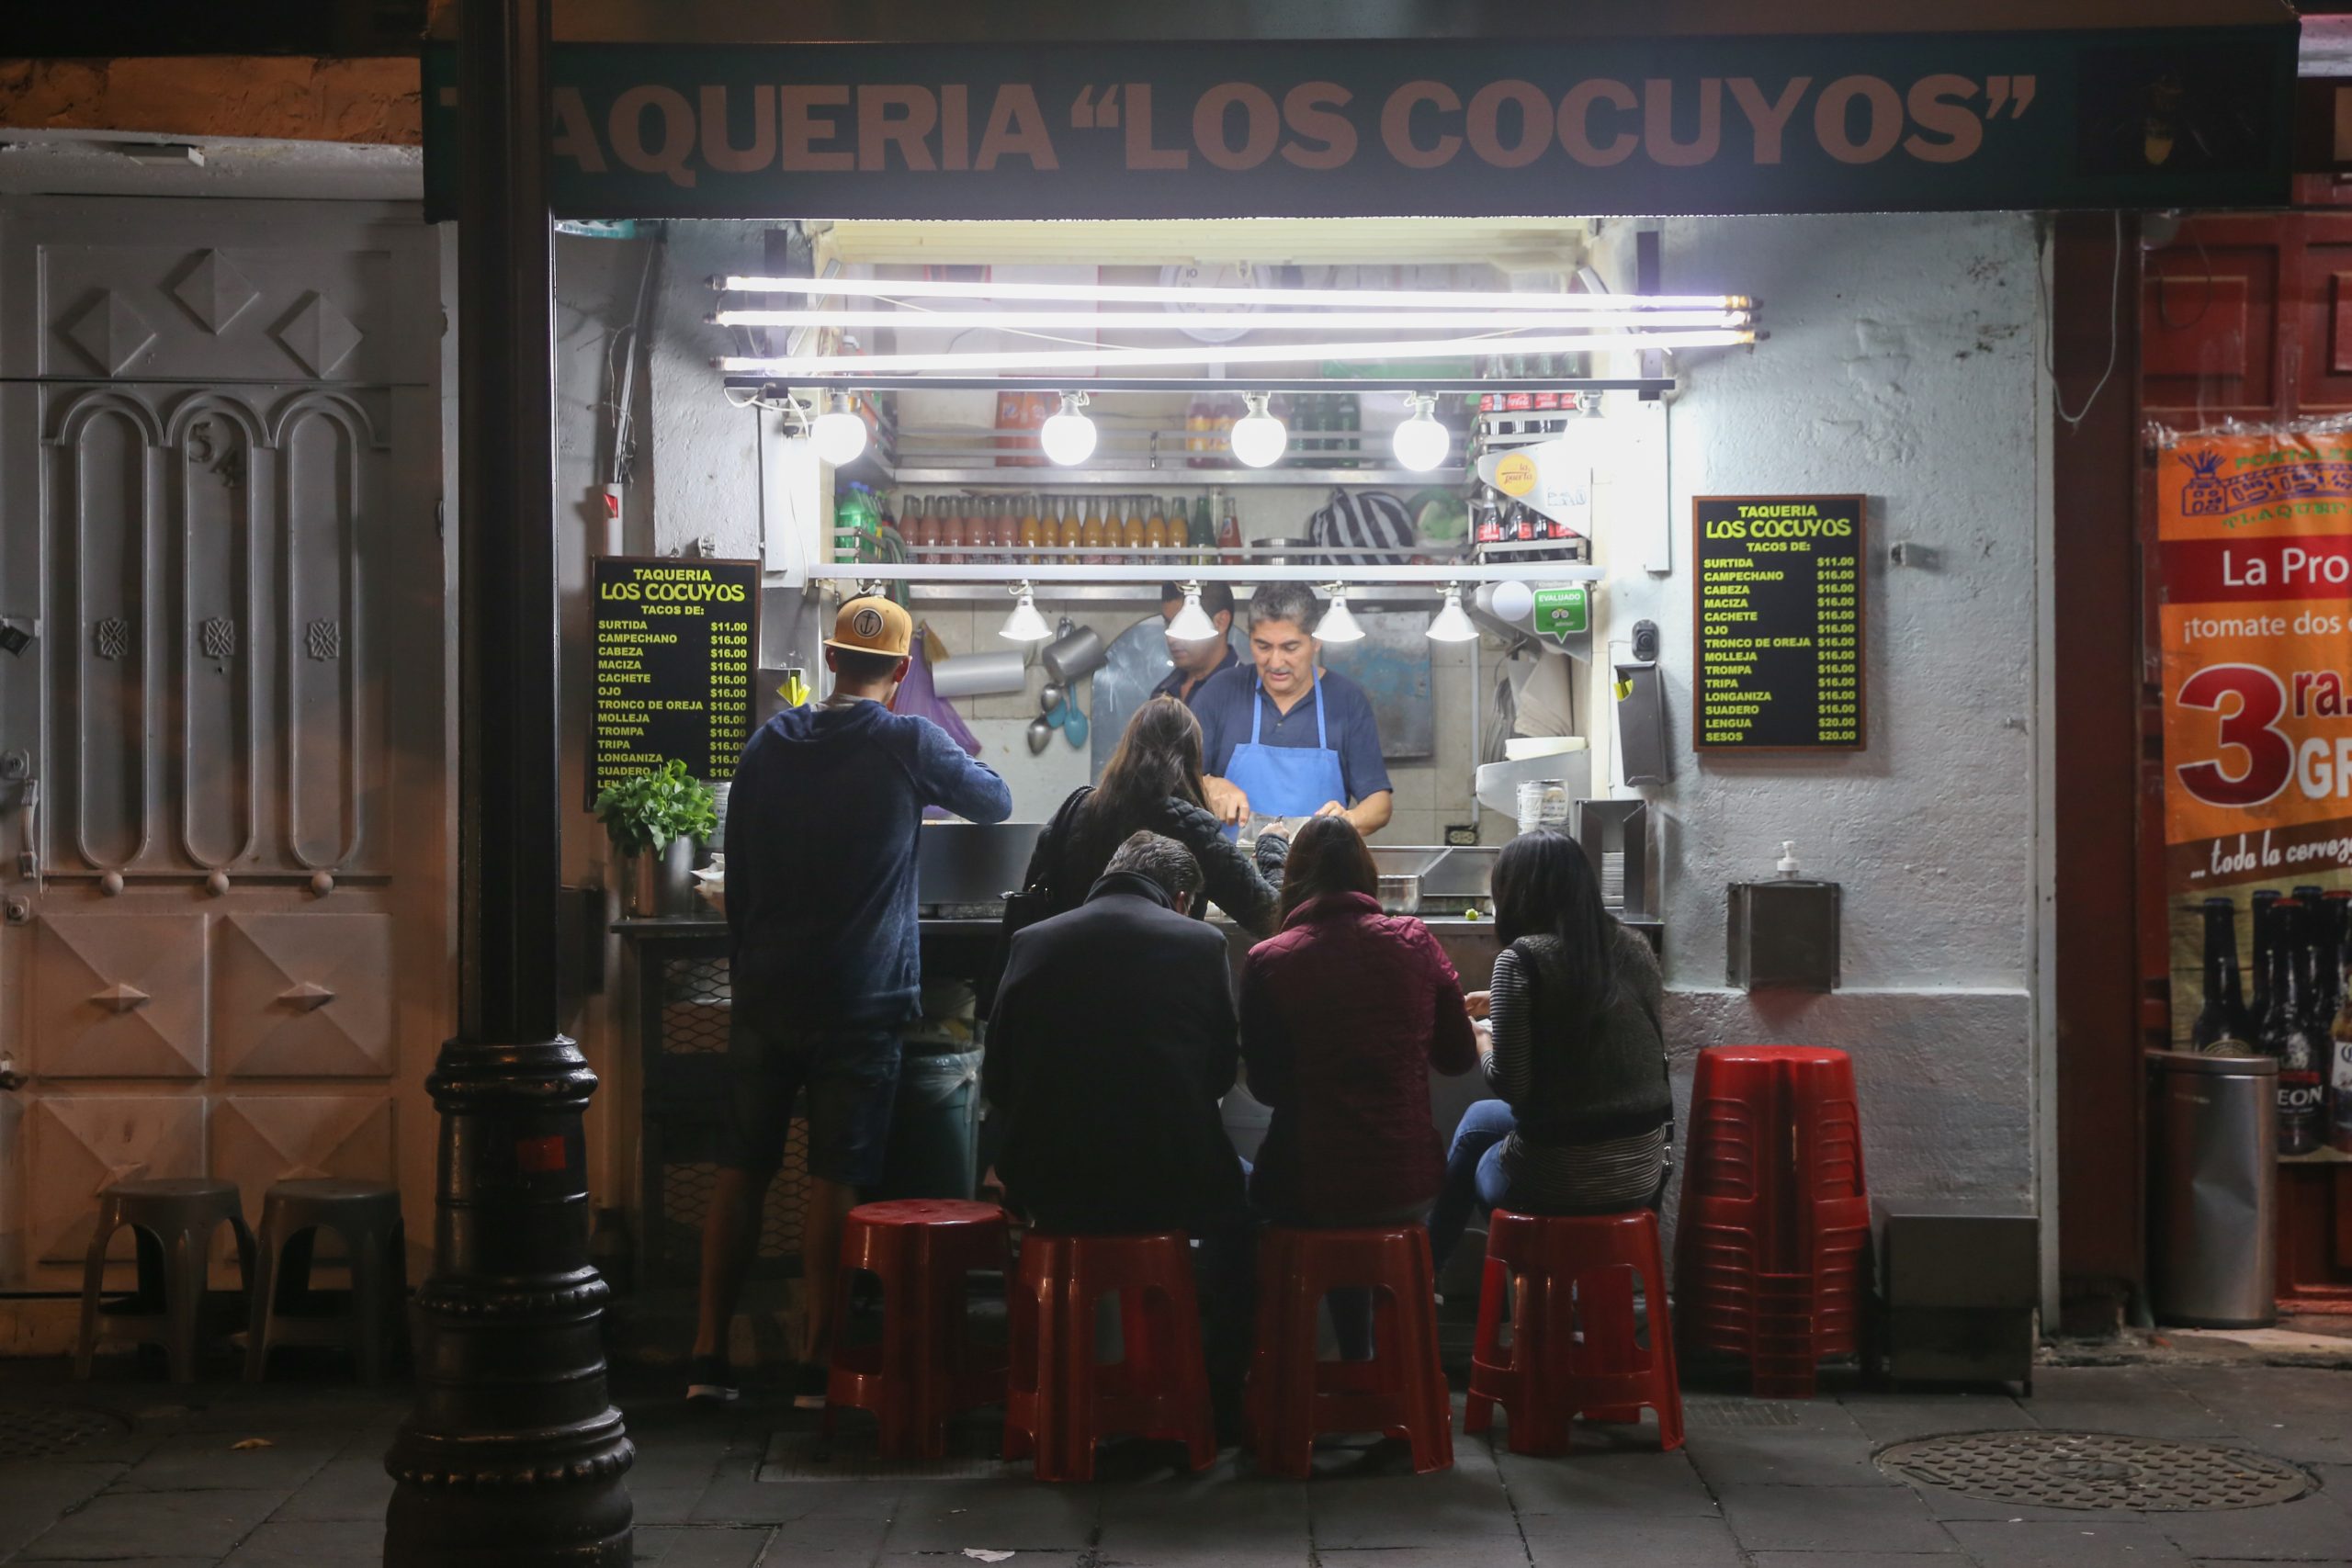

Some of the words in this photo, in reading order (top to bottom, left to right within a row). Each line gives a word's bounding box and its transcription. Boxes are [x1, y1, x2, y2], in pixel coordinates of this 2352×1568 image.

[439, 83, 1059, 186] AQUERIA
[1737, 504, 1819, 519] TAQUERIA
[2222, 502, 2352, 529] TLAQUEP
[1705, 520, 1747, 539] LOS
[1749, 518, 1852, 538] COCUYOS
[1746, 541, 1788, 552] TACOS
[1791, 541, 1811, 552] DE:
[1703, 558, 1754, 569] SURTIDA
[1816, 557, 1855, 567] $11.00
[2222, 549, 2267, 586] La
[2281, 547, 2349, 584] Pro
[633, 568, 713, 582] TAQUERIA
[1703, 570, 1784, 582] CAMPECHANO
[1817, 570, 1856, 581] $16.00
[601, 581, 641, 602] LOS
[644, 582, 746, 603] COCUYOS
[1703, 584, 1750, 595] CABEZA
[1817, 583, 1855, 593] $16.00
[1538, 593, 1581, 603] EVALUADO
[1703, 598, 1748, 609] MACIZA
[1816, 597, 1855, 607] $16.00
[641, 604, 682, 615] TACOS
[684, 605, 705, 615] DE:
[1703, 611, 1758, 622] CACHETE
[1817, 610, 1856, 621] $16.00
[597, 620, 648, 629] SURTIDA
[710, 622, 749, 632] $11.00
[1704, 626, 1729, 636] OJO
[1817, 624, 1856, 634] $16.00
[2184, 615, 2286, 644] ¡tomate
[2293, 610, 2342, 635] dos
[597, 633, 678, 644] CAMPECHANO
[710, 635, 749, 646] $16.00
[1705, 638, 1753, 649] TRONCO
[1756, 637, 1770, 649] DE
[1773, 637, 1812, 648] OREJA
[1817, 637, 1856, 647] $16.00
[598, 646, 644, 658] CABEZA
[709, 648, 749, 659] $16.00
[1704, 650, 1758, 662] MOLLEJA
[1817, 650, 1856, 661] $16.00
[597, 660, 641, 671] MACIZA
[710, 661, 748, 672] $16.00
[1705, 665, 1753, 675] TROMPA
[1817, 664, 1856, 675] $16.00
[598, 672, 650, 683] CACHETE
[710, 674, 748, 685] $16.00
[1705, 679, 1739, 688] TRIPA
[1818, 676, 1856, 688] $16.00
[597, 687, 623, 696] OJO
[710, 687, 747, 699] $16.00
[1704, 691, 1772, 702] LONGANIZA
[1818, 691, 1856, 701] $16.00
[598, 699, 644, 710] TRONCO
[649, 700, 663, 710] DE
[668, 700, 704, 711] OREJA
[710, 701, 747, 712] $16.00
[1705, 705, 1760, 716] SUADERO
[1818, 704, 1856, 714] $16.00
[597, 713, 650, 723] MOLLEJA
[710, 714, 747, 725] $16.00
[1705, 718, 1752, 728] LENGUA
[1818, 716, 1856, 728] $20.00
[598, 726, 644, 736] TROMPA
[710, 728, 747, 739] $16.00
[1705, 731, 1744, 741] SESOS
[1818, 730, 1856, 740] $20.00
[599, 739, 630, 750] TRIPA
[596, 753, 662, 762] LONGANIZA
[710, 754, 740, 764] $16.0
[597, 766, 651, 777] SUADERO
[710, 768, 734, 777] $16.
[598, 779, 620, 790] LEN
[2211, 833, 2256, 875] toda
[2262, 829, 2281, 867] la
[2286, 837, 2352, 863] cervez
[2278, 1085, 2323, 1106] EON
